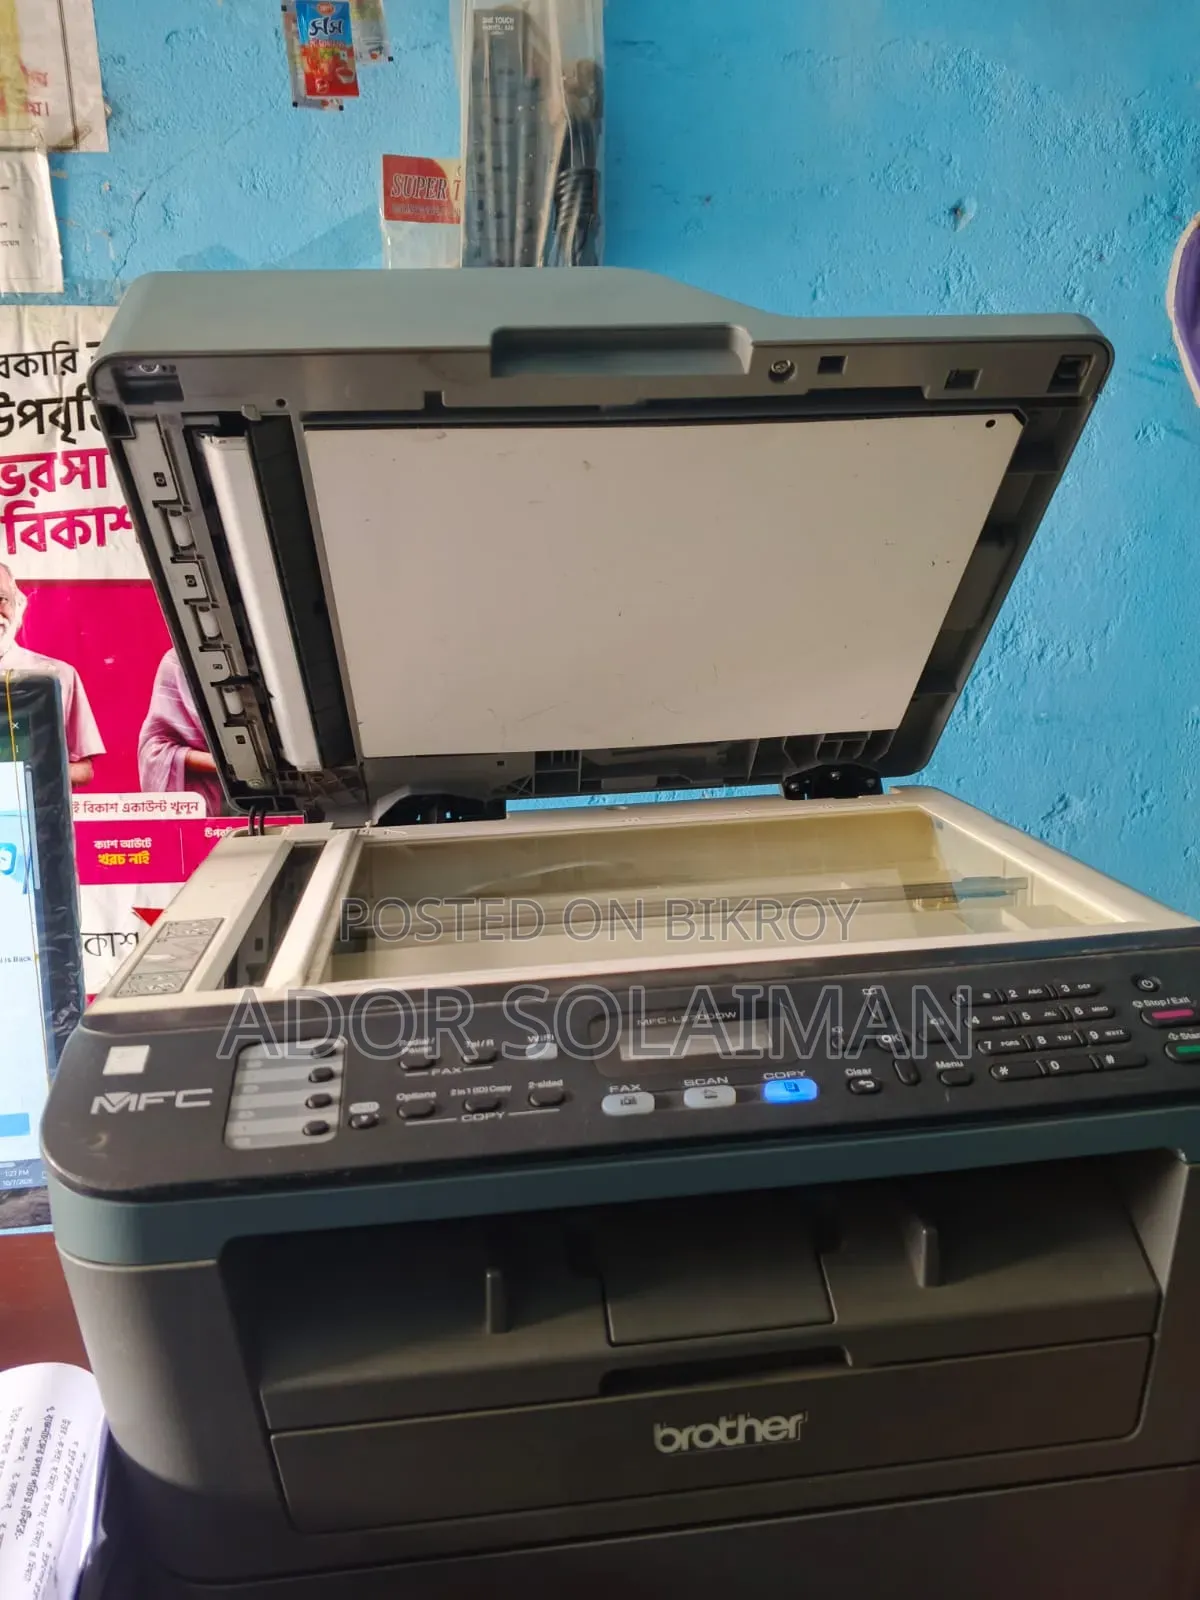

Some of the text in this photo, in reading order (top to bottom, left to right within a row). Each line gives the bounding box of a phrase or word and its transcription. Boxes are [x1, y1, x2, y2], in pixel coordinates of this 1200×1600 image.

[391, 173, 448, 201] SUPER
[83, 801, 118, 813] বিকাশ
[1008, 989, 1018, 998] 2
[1061, 984, 1070, 993] 3
[1074, 1005, 1083, 1016] 6
[1022, 1011, 1031, 1021] 5
[1037, 1035, 1047, 1045] 8
[1089, 1030, 1099, 1040] 9
[983, 1040, 992, 1050] 7
[431, 1067, 463, 1077] FAX
[763, 1069, 806, 1080] COPY
[683, 1076, 729, 1087] SCAN
[609, 1083, 642, 1093] FAX
[90, 1088, 213, 1115] MFC
[461, 1111, 505, 1122] COPY
[653, 1413, 804, 1453] brother
